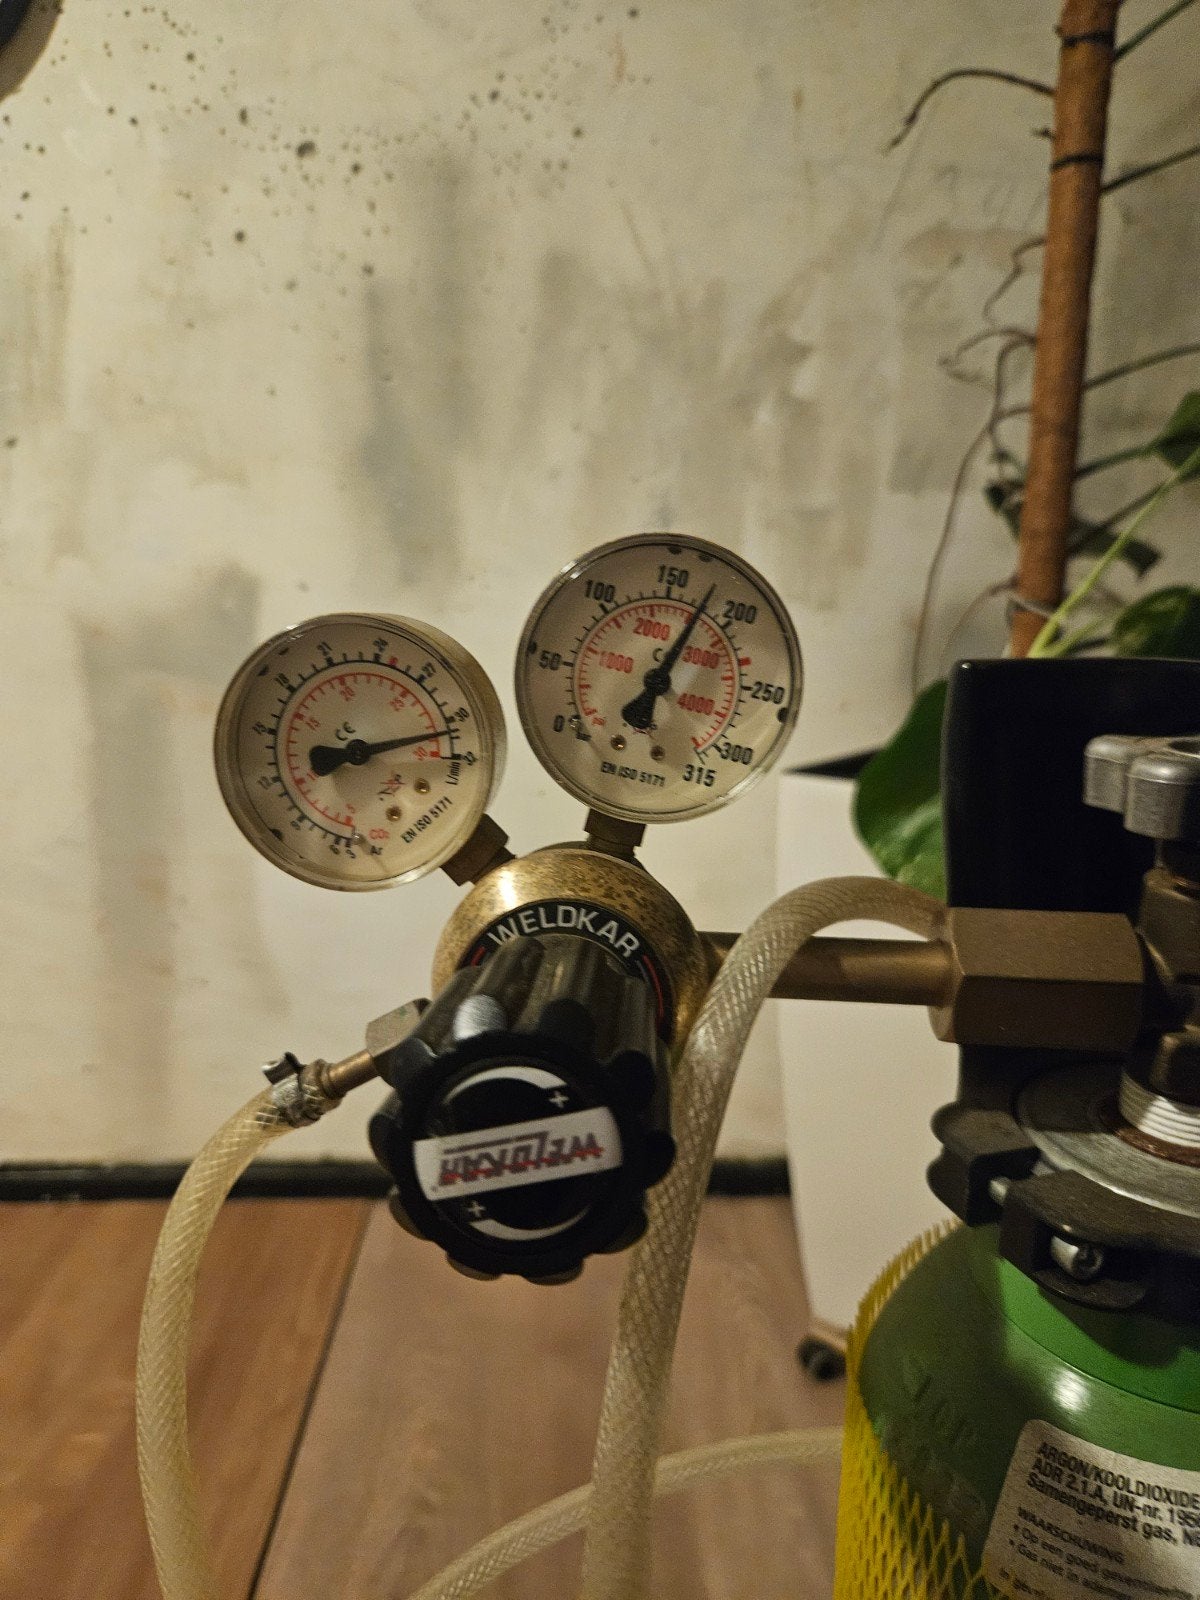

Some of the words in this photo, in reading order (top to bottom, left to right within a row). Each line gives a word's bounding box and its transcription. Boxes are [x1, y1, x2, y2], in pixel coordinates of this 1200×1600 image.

[657, 564, 690, 588] 150
[584, 579, 616, 602] 100
[724, 601, 757, 625] 200
[633, 618, 671, 641] 2000
[538, 652, 562, 671] 50
[682, 645, 720, 669] 3000
[677, 693, 716, 715] 4000
[751, 681, 785, 704] 250
[454, 707, 470, 722] 30
[553, 715, 565, 732] 0
[720, 745, 754, 765] 300
[682, 764, 717, 787] 315
[401, 828, 417, 843] EN
[414, 815, 433, 832] ISO
[429, 796, 453, 818] 5171
[488, 905, 640, 959] WELDKAR
[1032, 1458, 1064, 1484] ADR
[1037, 1442, 1200, 1510] ARGON/KOOLDIOXIDE
[1027, 1472, 1138, 1533] Samengeperst
